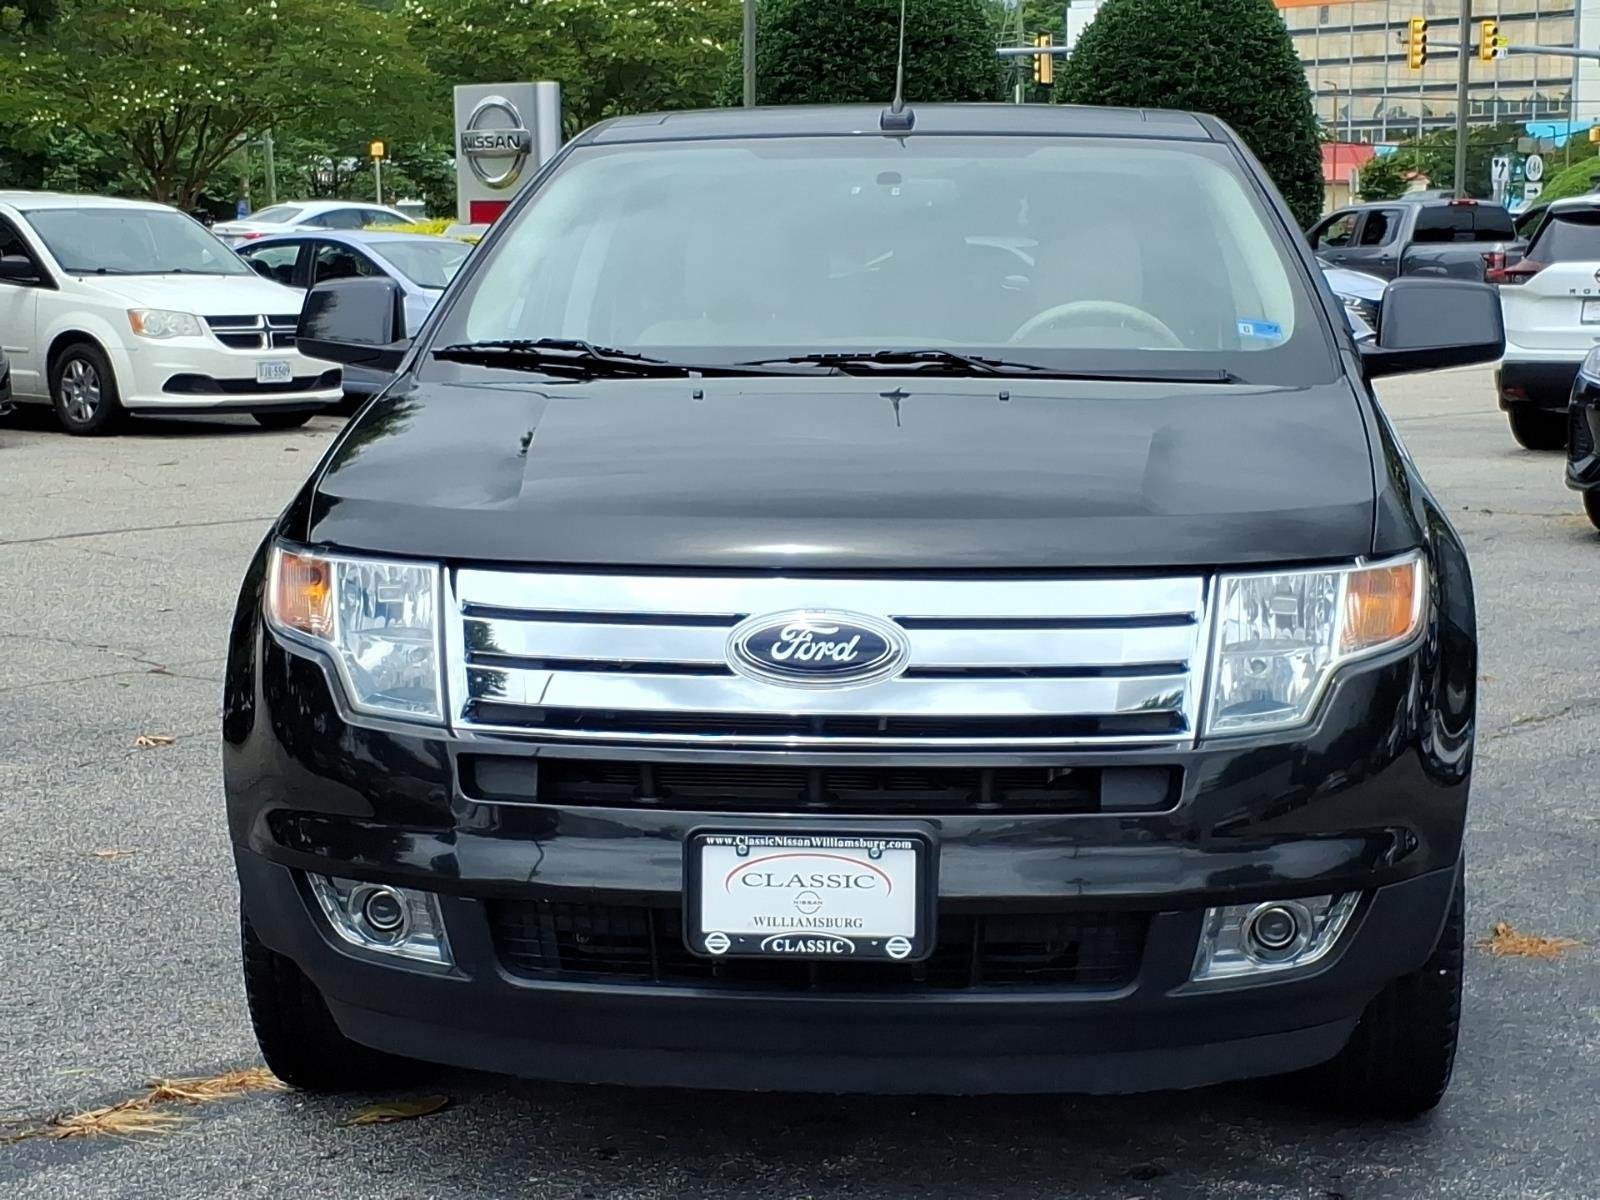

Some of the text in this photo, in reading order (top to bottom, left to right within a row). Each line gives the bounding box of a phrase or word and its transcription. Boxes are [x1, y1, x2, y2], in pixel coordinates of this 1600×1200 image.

[464, 136, 520, 149] NISSAN
[771, 622, 860, 661] Ford
[706, 835, 912, 850] www.ClassicNissanWilliamsburg.com
[741, 873, 876, 889] CLASSIC
[753, 916, 863, 929] WILLIAMSBURG
[772, 939, 844, 953] CLASSIC
